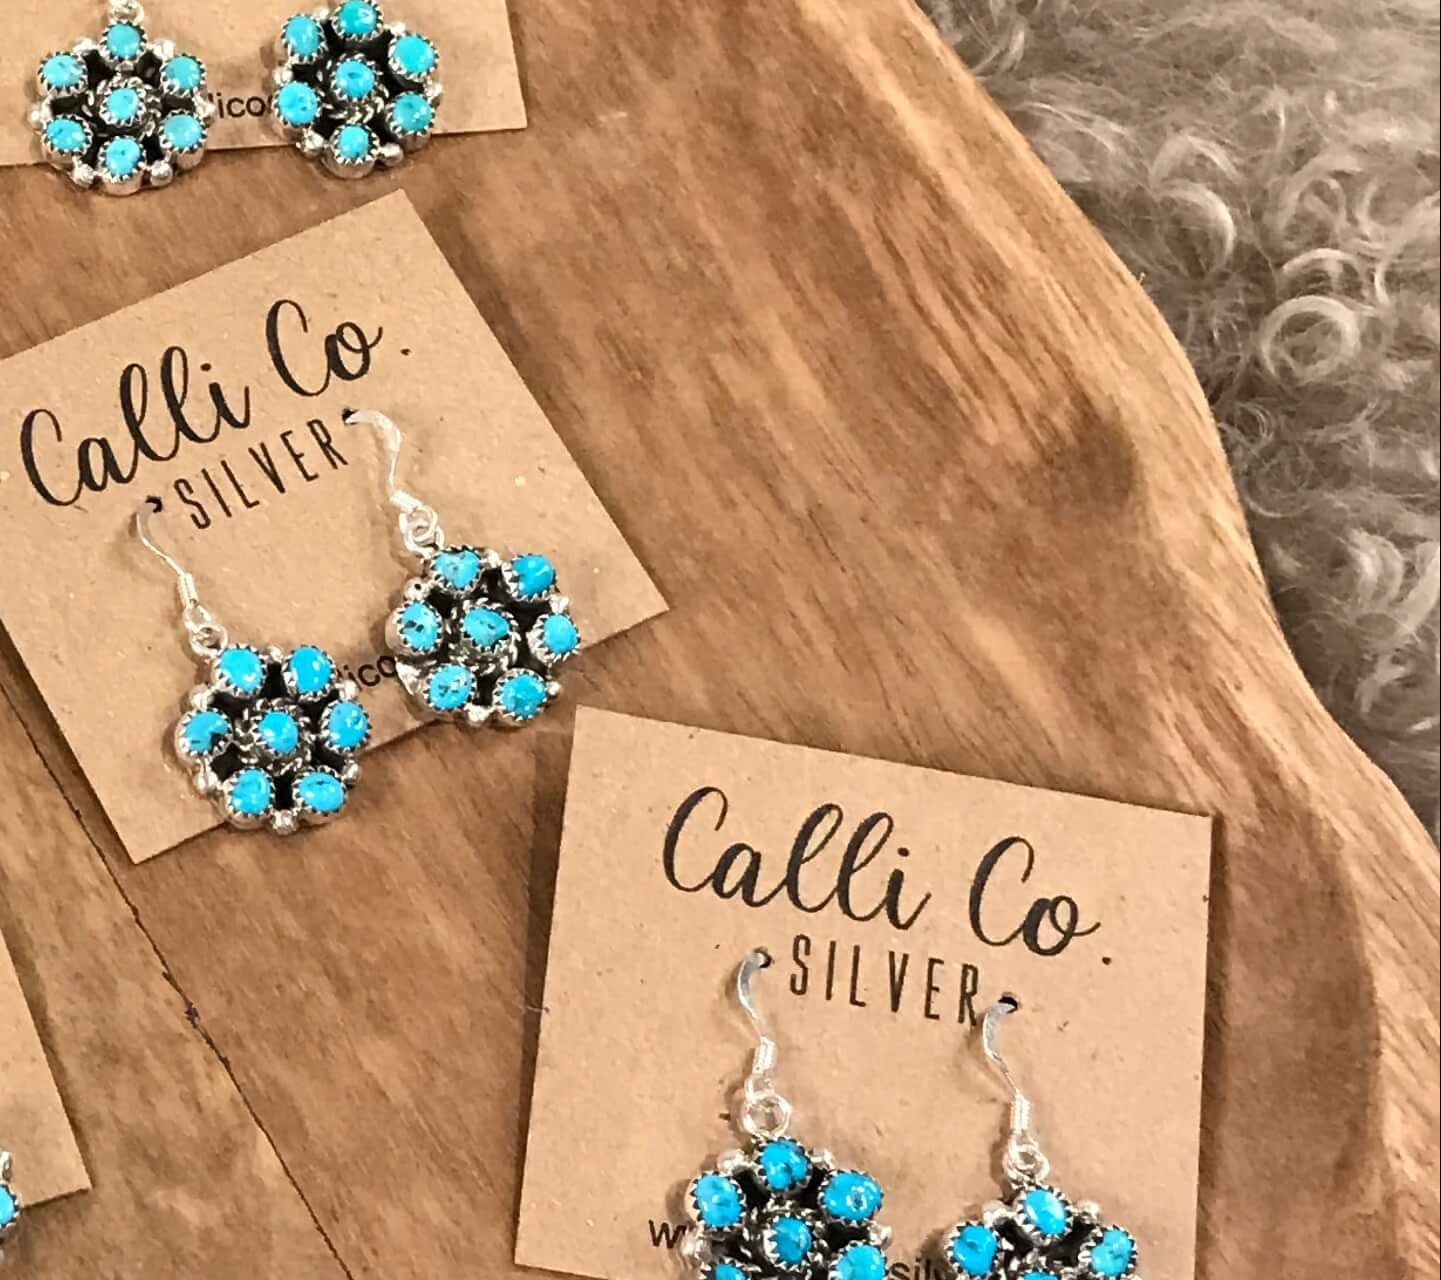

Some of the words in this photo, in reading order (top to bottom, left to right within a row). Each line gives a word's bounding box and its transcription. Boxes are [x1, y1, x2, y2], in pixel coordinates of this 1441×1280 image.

[20, 345, 250, 508] Calli
[266, 299, 411, 396] Co.
[175, 419, 348, 530] SILVER
[663, 786, 931, 930] Calli
[968, 836, 1111, 966] Co.
[790, 934, 980, 1026] SILVER
